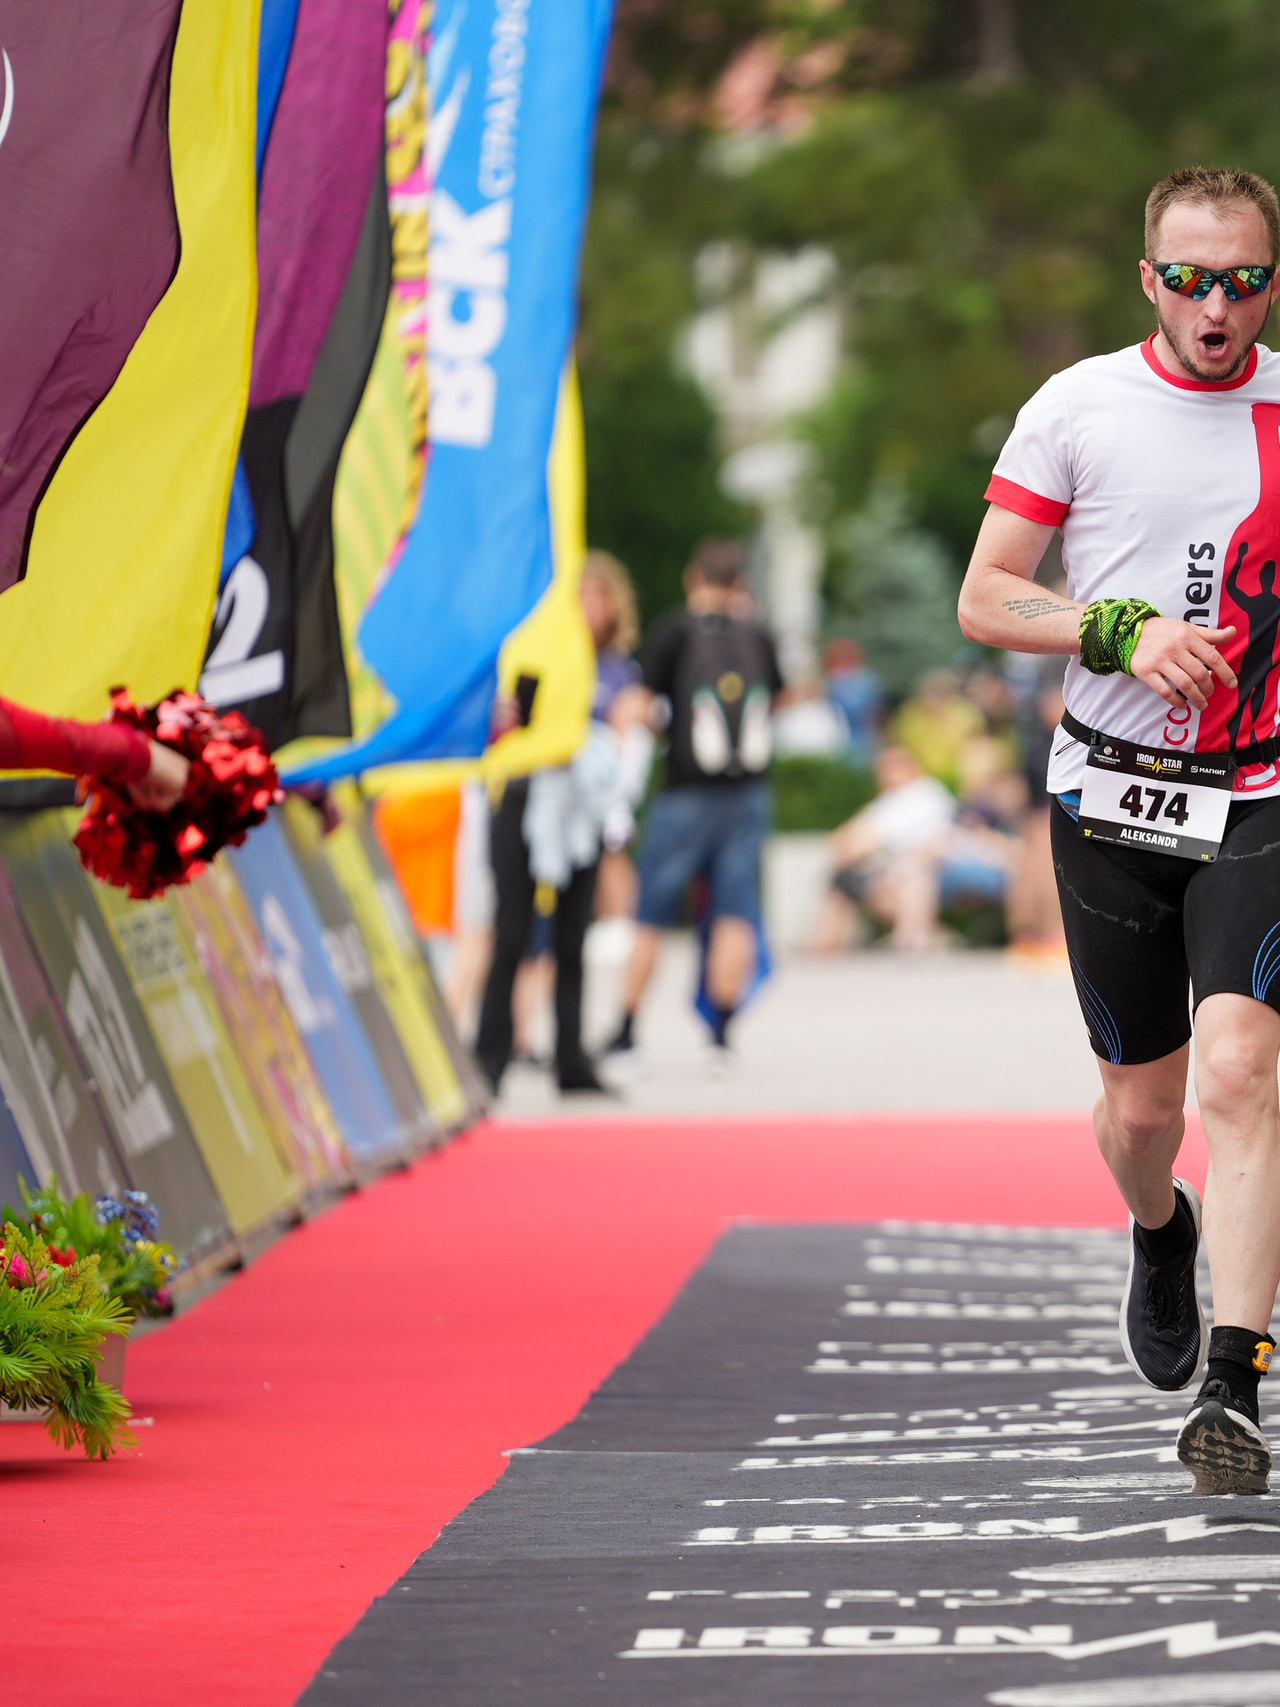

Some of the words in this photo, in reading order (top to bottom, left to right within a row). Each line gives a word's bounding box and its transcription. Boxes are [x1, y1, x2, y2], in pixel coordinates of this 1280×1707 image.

[1136, 752, 1156, 764] IRON
[1162, 757, 1183, 769] STAR
[1198, 767, 1227, 776] МАГНИТ
[1119, 784, 1190, 826] 474
[1120, 828, 1178, 848] ALEKSANDR
[690, 1516, 1081, 1542] IRON
[632, 1623, 1076, 1650] IRON
